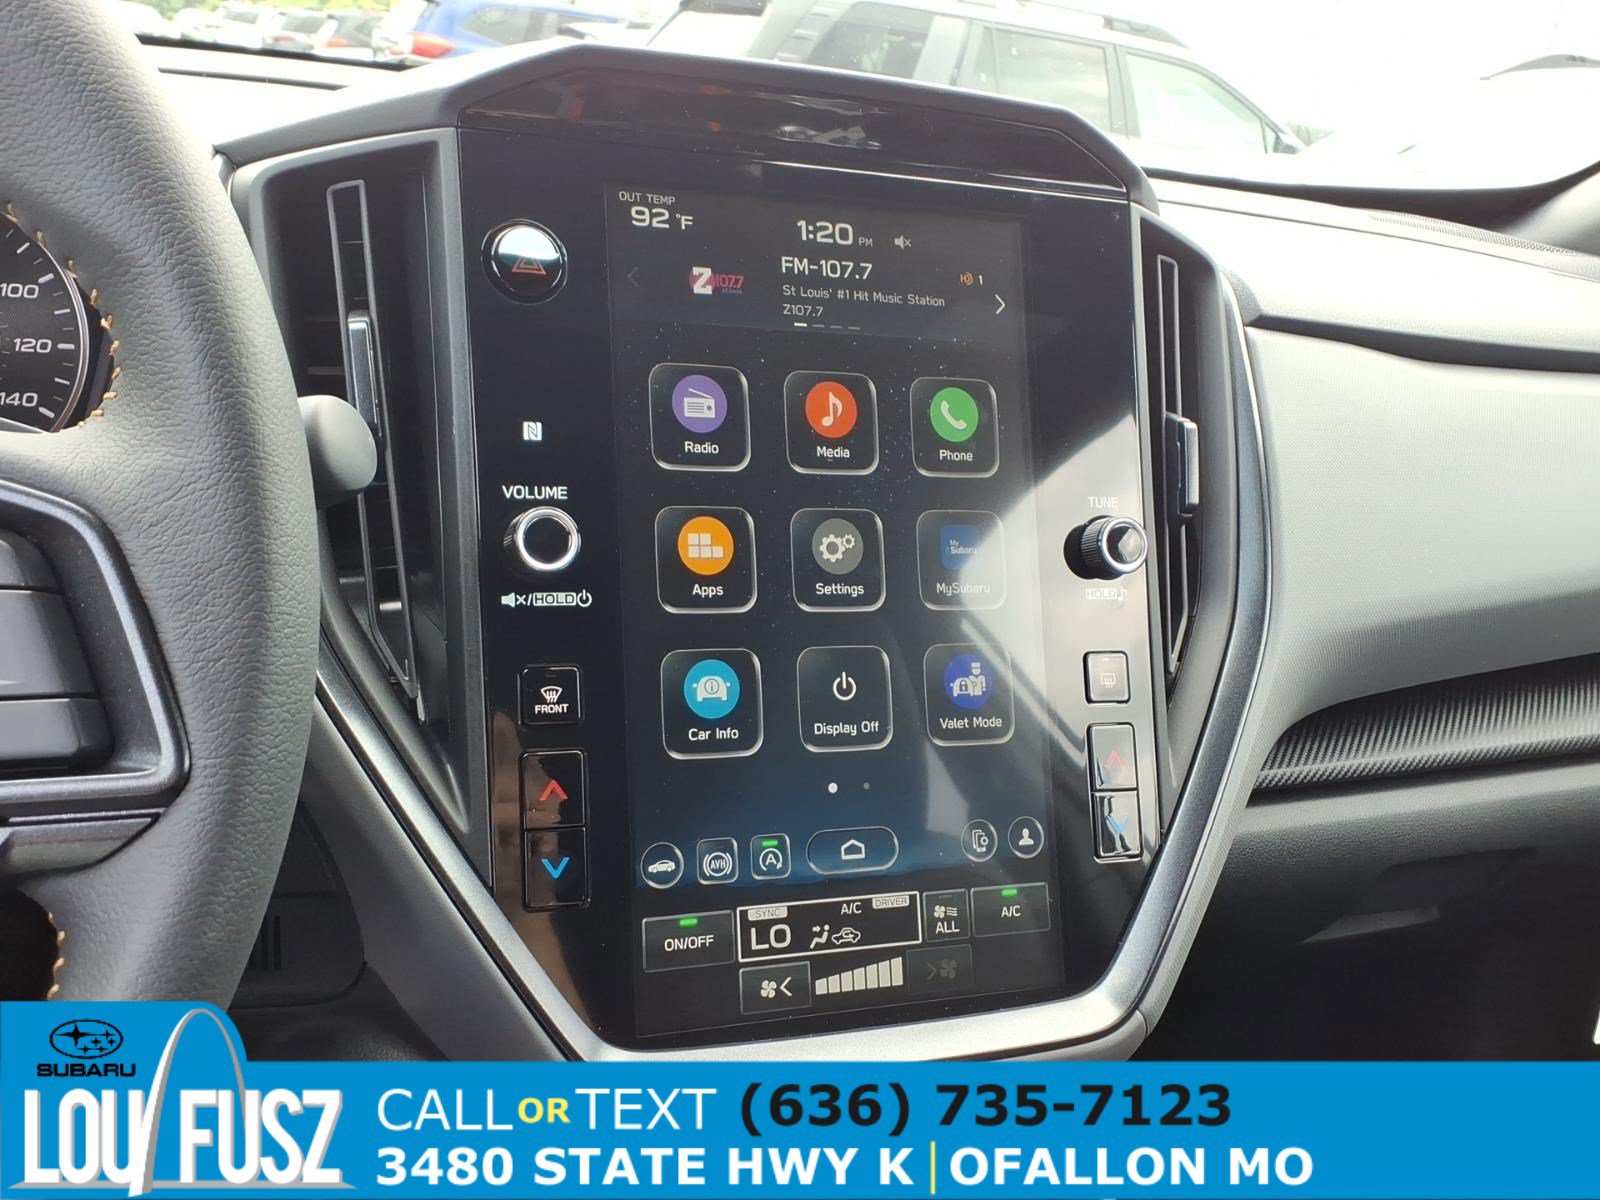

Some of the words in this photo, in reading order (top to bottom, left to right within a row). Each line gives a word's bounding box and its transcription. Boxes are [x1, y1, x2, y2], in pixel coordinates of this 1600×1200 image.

[618, 191, 642, 203] OUT
[646, 193, 676, 206] TEMP
[630, 206, 670, 228] 92
[797, 220, 854, 245] 1:20
[858, 237, 873, 247] PM
[781, 256, 873, 280] FM-107.7
[0, 283, 39, 298] 100
[782, 284, 796, 296] St
[800, 286, 833, 299] Louis'
[836, 289, 850, 300] #1
[854, 291, 869, 302] Hit
[873, 292, 903, 305] Music
[907, 294, 945, 307] Station
[783, 304, 824, 317] Z107.7
[13, 338, 52, 353] 120
[0, 392, 38, 407] 140
[684, 441, 719, 455] Radio
[816, 446, 850, 459] Media
[939, 449, 973, 462] Phone
[502, 485, 568, 500] VOLUME
[1088, 496, 1119, 508] TUNE
[692, 584, 724, 598] Apps
[815, 582, 865, 597] Settings
[936, 582, 990, 596] MySubaru
[535, 703, 569, 715] FRONT
[813, 722, 857, 737] Display
[861, 720, 880, 734] Off
[939, 716, 968, 730] Valet
[973, 716, 1003, 729] Mode
[688, 728, 709, 741] Car
[716, 727, 739, 740] Info
[710, 858, 727, 870] AVH
[840, 902, 862, 915] A/C
[874, 897, 908, 908] DRIVER
[755, 908, 781, 919] SYNC
[1001, 905, 1022, 918] A/C
[935, 921, 960, 934] ALL
[664, 935, 714, 952] ON/OFF
[750, 924, 791, 950] LO
